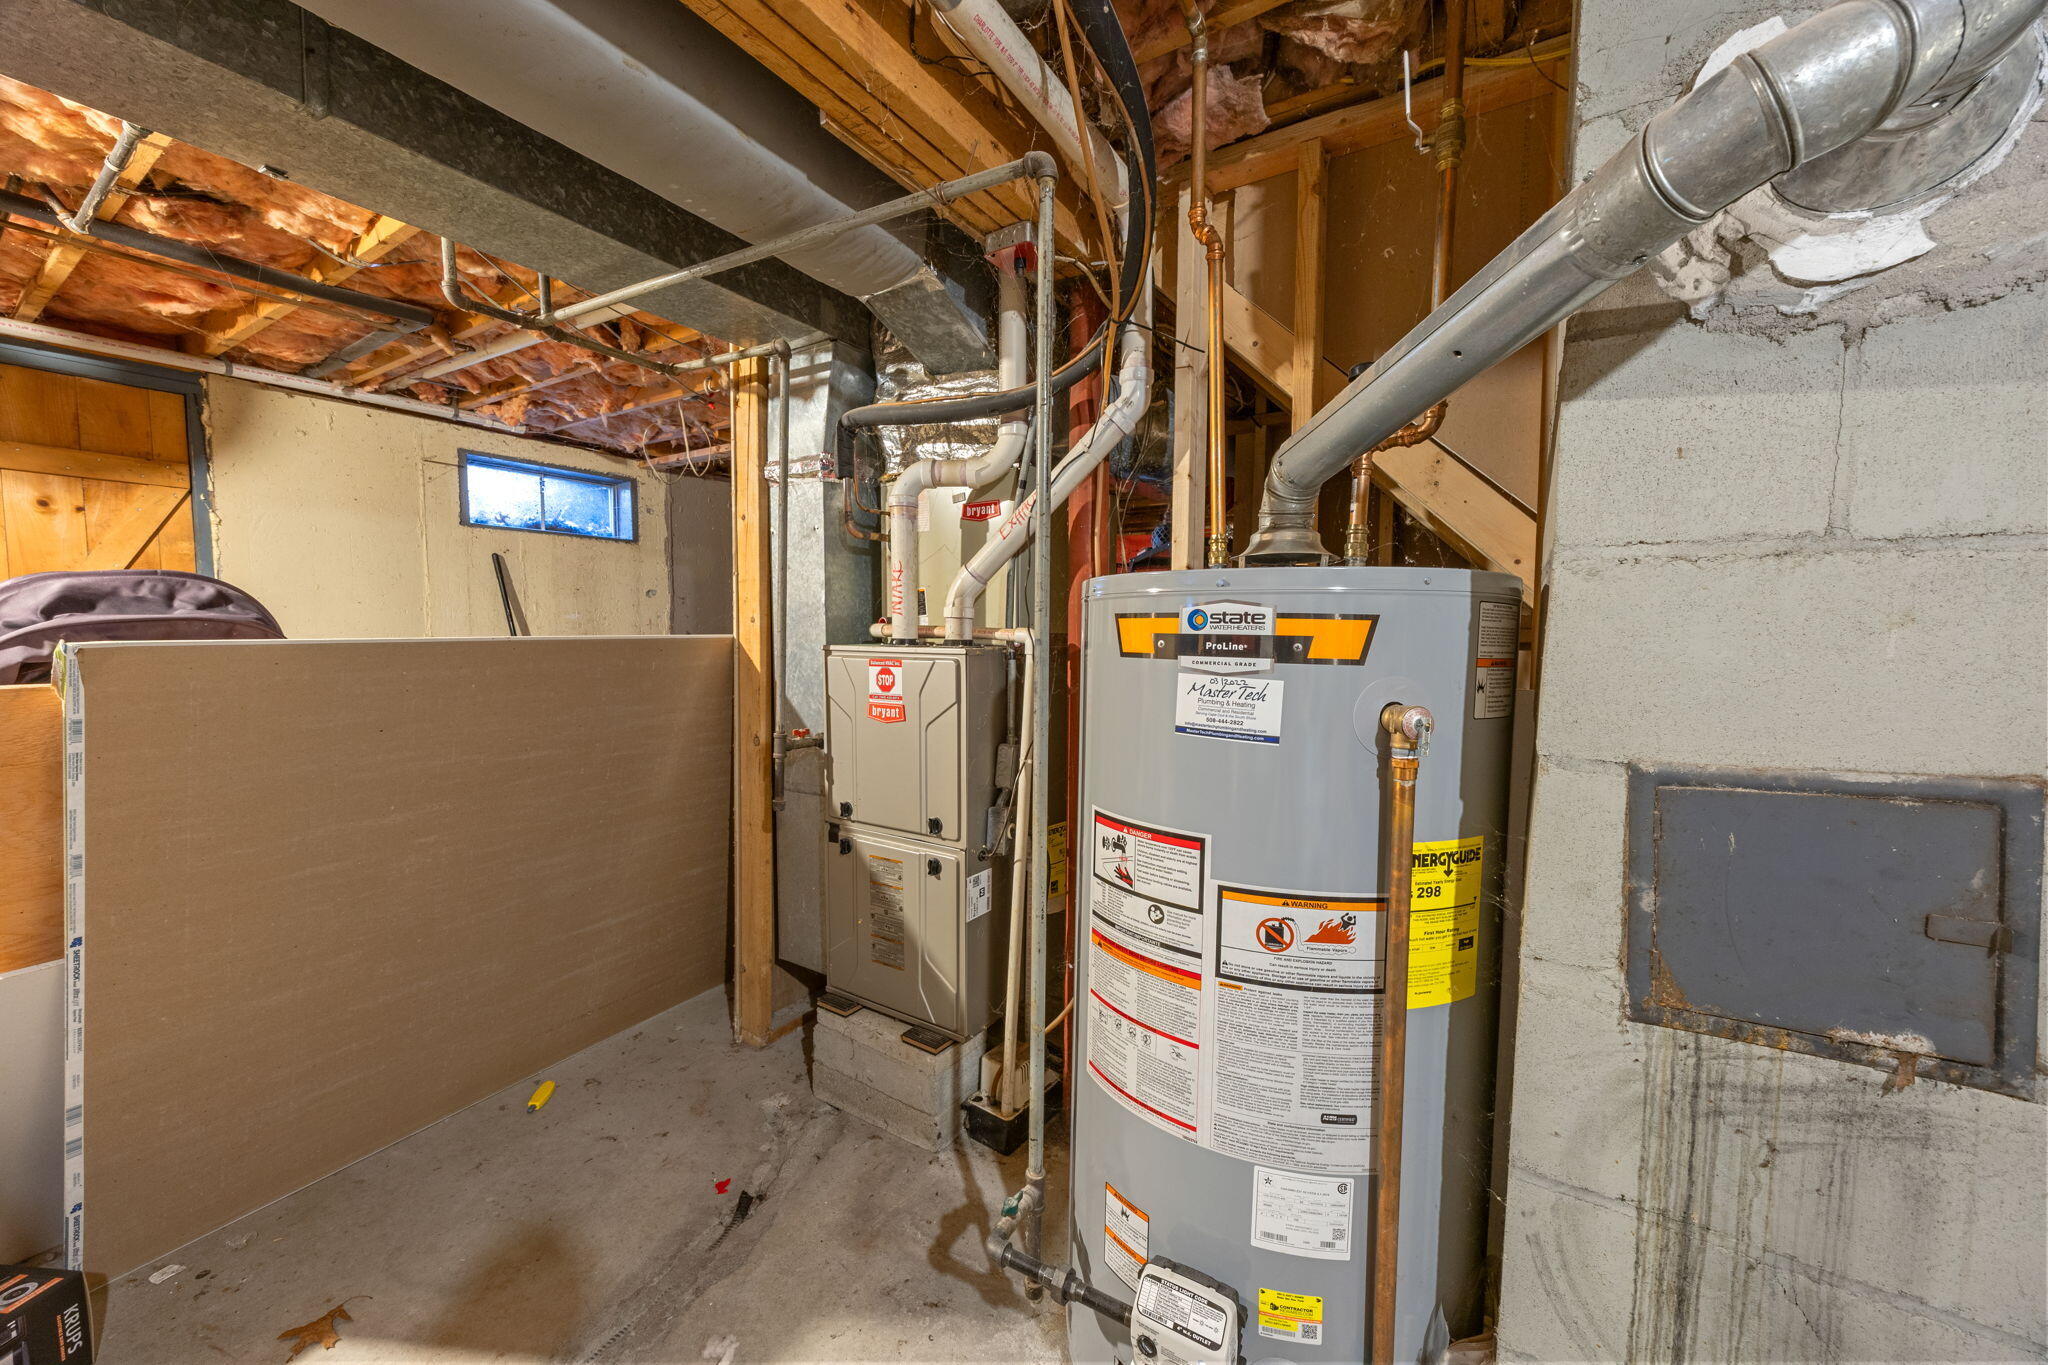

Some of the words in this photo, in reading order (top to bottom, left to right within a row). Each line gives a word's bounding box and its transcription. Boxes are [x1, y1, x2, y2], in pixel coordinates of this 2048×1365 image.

[967, 503, 995, 517] bryant
[1210, 611, 1266, 625] state
[878, 674, 894, 686] STOP
[1198, 697, 1224, 707] Plumbing
[1232, 701, 1256, 709] Heating
[872, 705, 900, 718] bryant
[1130, 828, 1152, 839] DANGER
[1417, 886, 1441, 898] 298
[1291, 901, 1328, 910] WARNING
[1161, 1280, 1178, 1292] STATUS
[1180, 1287, 1194, 1298] LIGHT
[1195, 1294, 1208, 1305] CODE
[1280, 1305, 1313, 1313] CONTRACTOR
[64, 1303, 83, 1355] KRUPS
[1193, 1331, 1212, 1346] OUTLET
